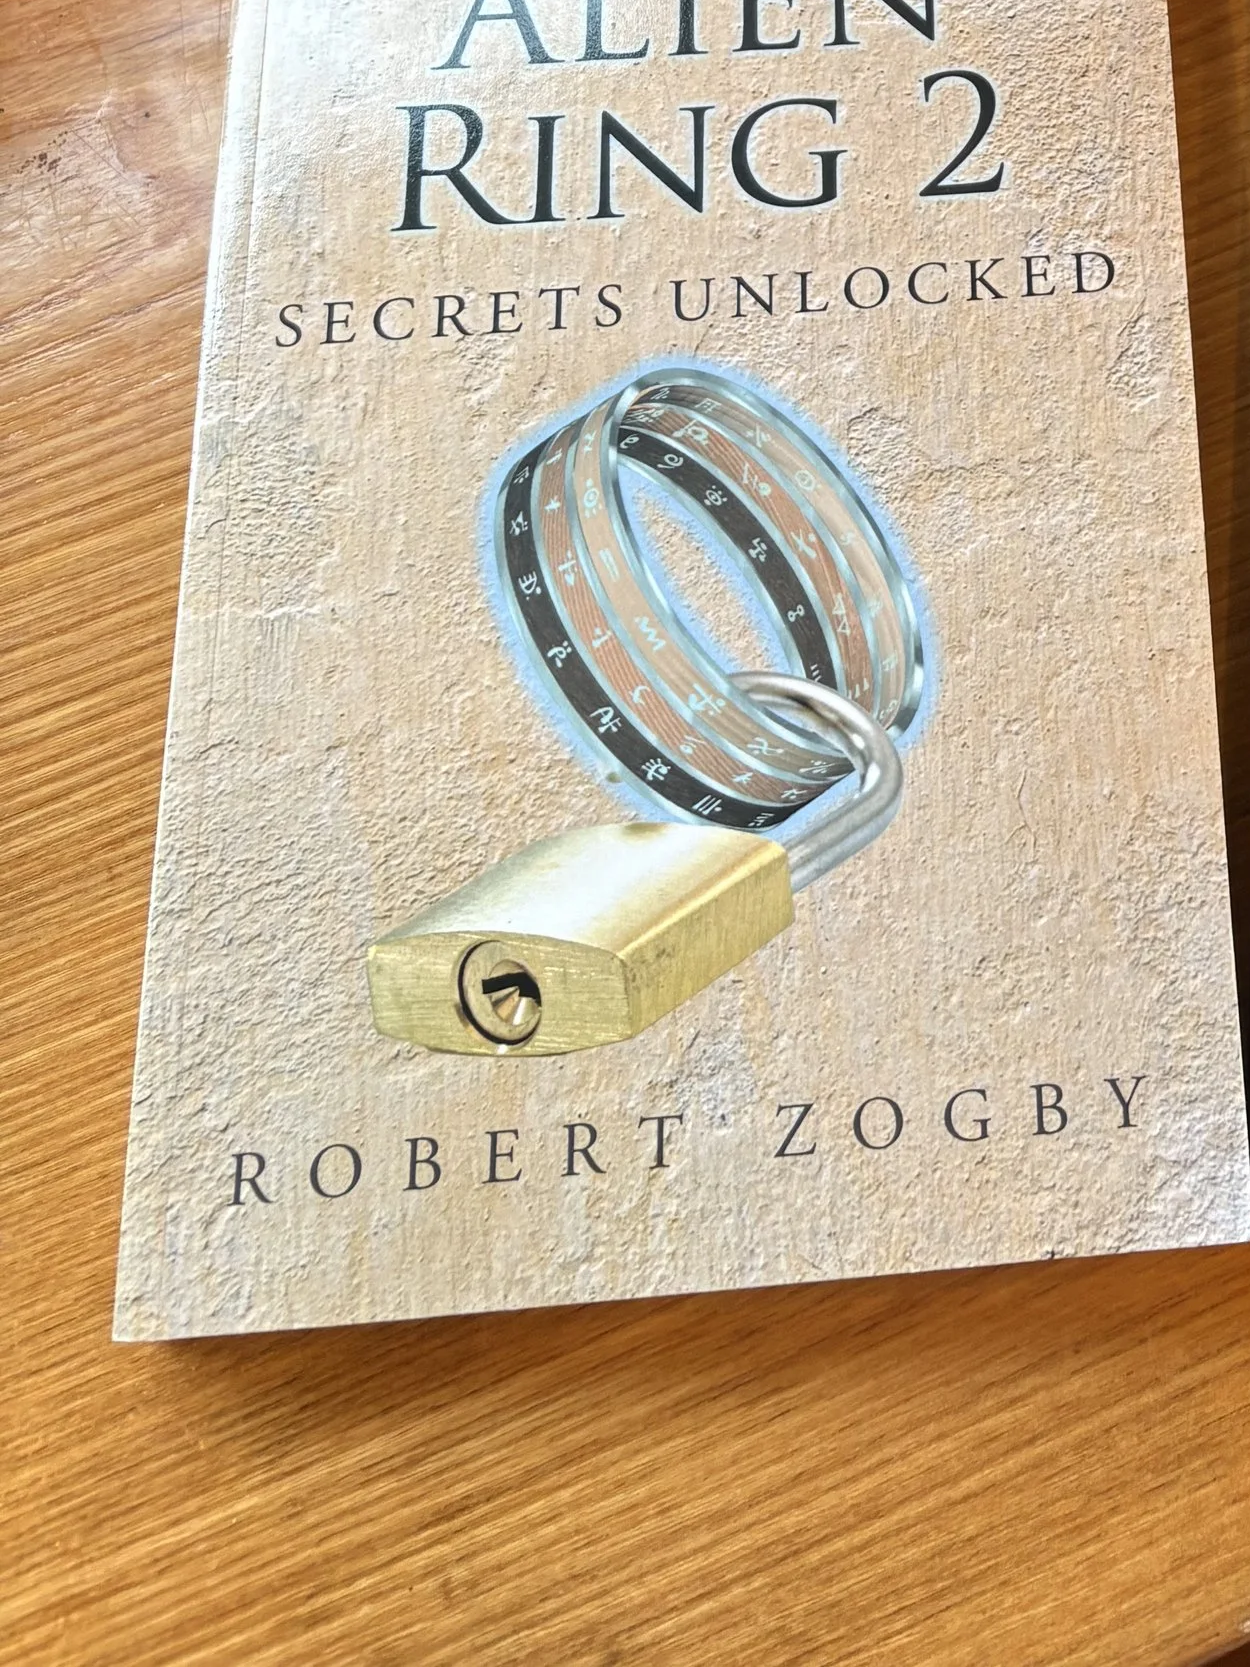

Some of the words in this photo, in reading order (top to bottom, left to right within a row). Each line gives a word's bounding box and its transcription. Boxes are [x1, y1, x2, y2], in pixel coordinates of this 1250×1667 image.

[391, 98, 848, 231] RING
[918, 70, 1005, 197] 2
[276, 283, 624, 348] SECRETS
[671, 250, 1116, 323] UNLOCKED
[228, 1114, 683, 1207] ROBERT
[775, 1075, 1148, 1158] ZOGBY
